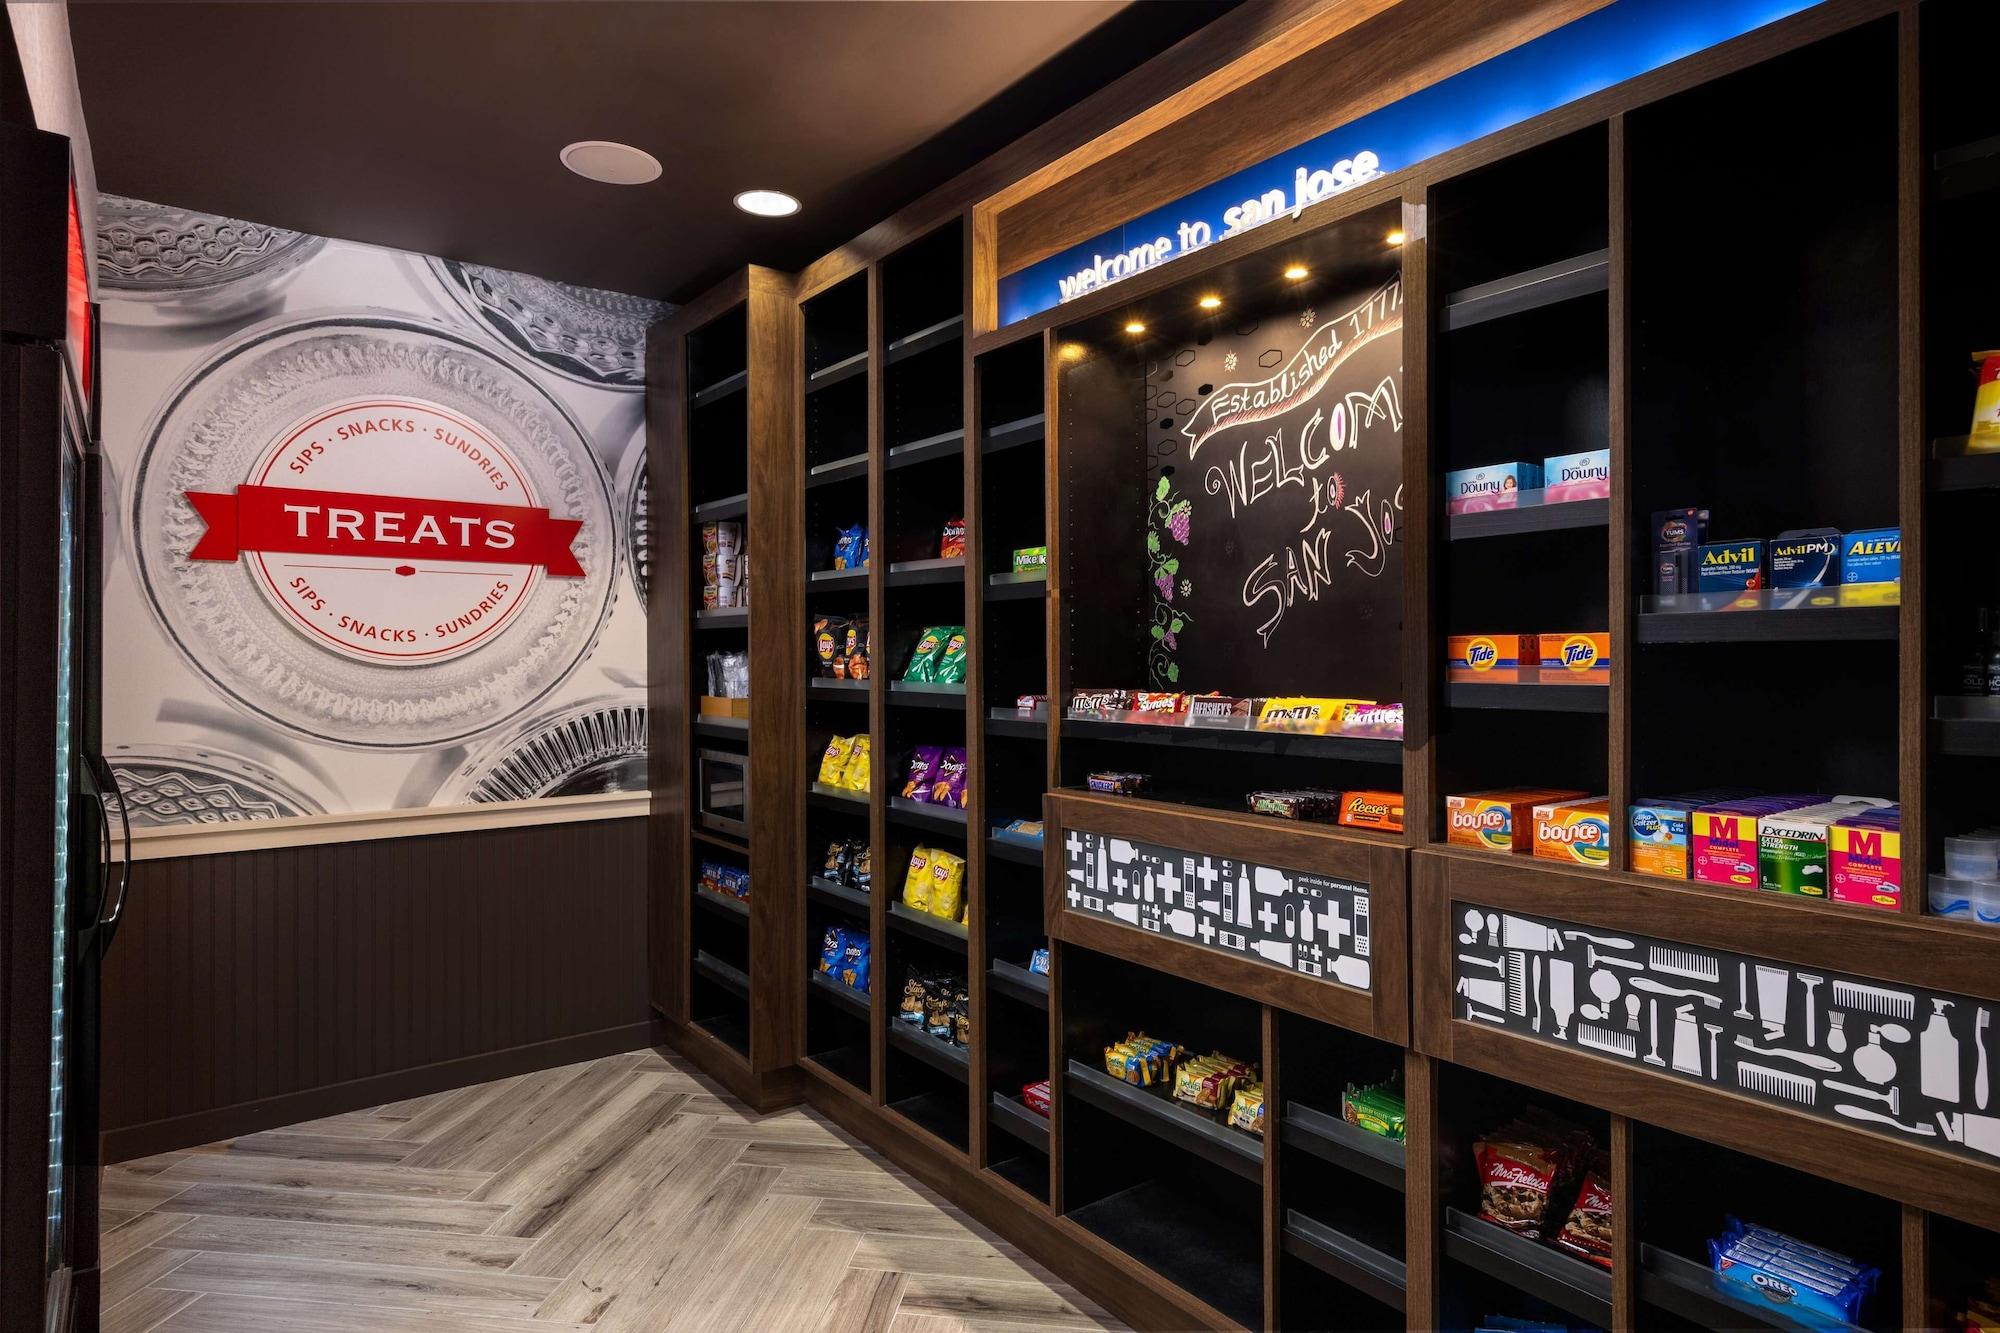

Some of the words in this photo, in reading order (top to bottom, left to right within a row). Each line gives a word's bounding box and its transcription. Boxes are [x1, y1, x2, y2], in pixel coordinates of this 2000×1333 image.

[1059, 237, 1172, 301] welcome
[1178, 220, 1211, 250] to
[1223, 188, 1285, 232] san
[1292, 150, 1380, 219] jose
[1211, 329, 1342, 425] Established
[1349, 281, 1400, 339] 1777
[1205, 366, 1402, 518] WELCOM
[289, 441, 325, 474] SIPS
[336, 418, 415, 440] SNACKS
[433, 428, 509, 491] SUNDRIES
[1562, 466, 1608, 481] Downy
[1460, 481, 1500, 494] Downy
[284, 503, 516, 549] TREATS
[1701, 547, 1755, 565] Advil
[1242, 528, 1331, 649] SAN
[290, 576, 326, 611] SIPS
[338, 615, 417, 642] SNACKS
[435, 581, 509, 638] SUNDRIES
[1469, 645, 1494, 666] Tide
[1565, 643, 1594, 666] Tide
[1194, 702, 1232, 717] HERSHEY'S
[1453, 811, 1502, 829] bounce
[1633, 819, 1659, 827] Seltzer
[1709, 815, 1739, 840] M
[1539, 822, 1598, 842] bounce
[1762, 826, 1824, 841] EXCEDRIN
[1761, 843, 1799, 851] STRENGTH
[1848, 830, 1882, 855] M
[1848, 862, 1882, 870] COMPLETE
[1330, 883, 1352, 891] personal
[904, 979, 926, 998] Stacy
[1752, 1274, 1798, 1297] OREO
